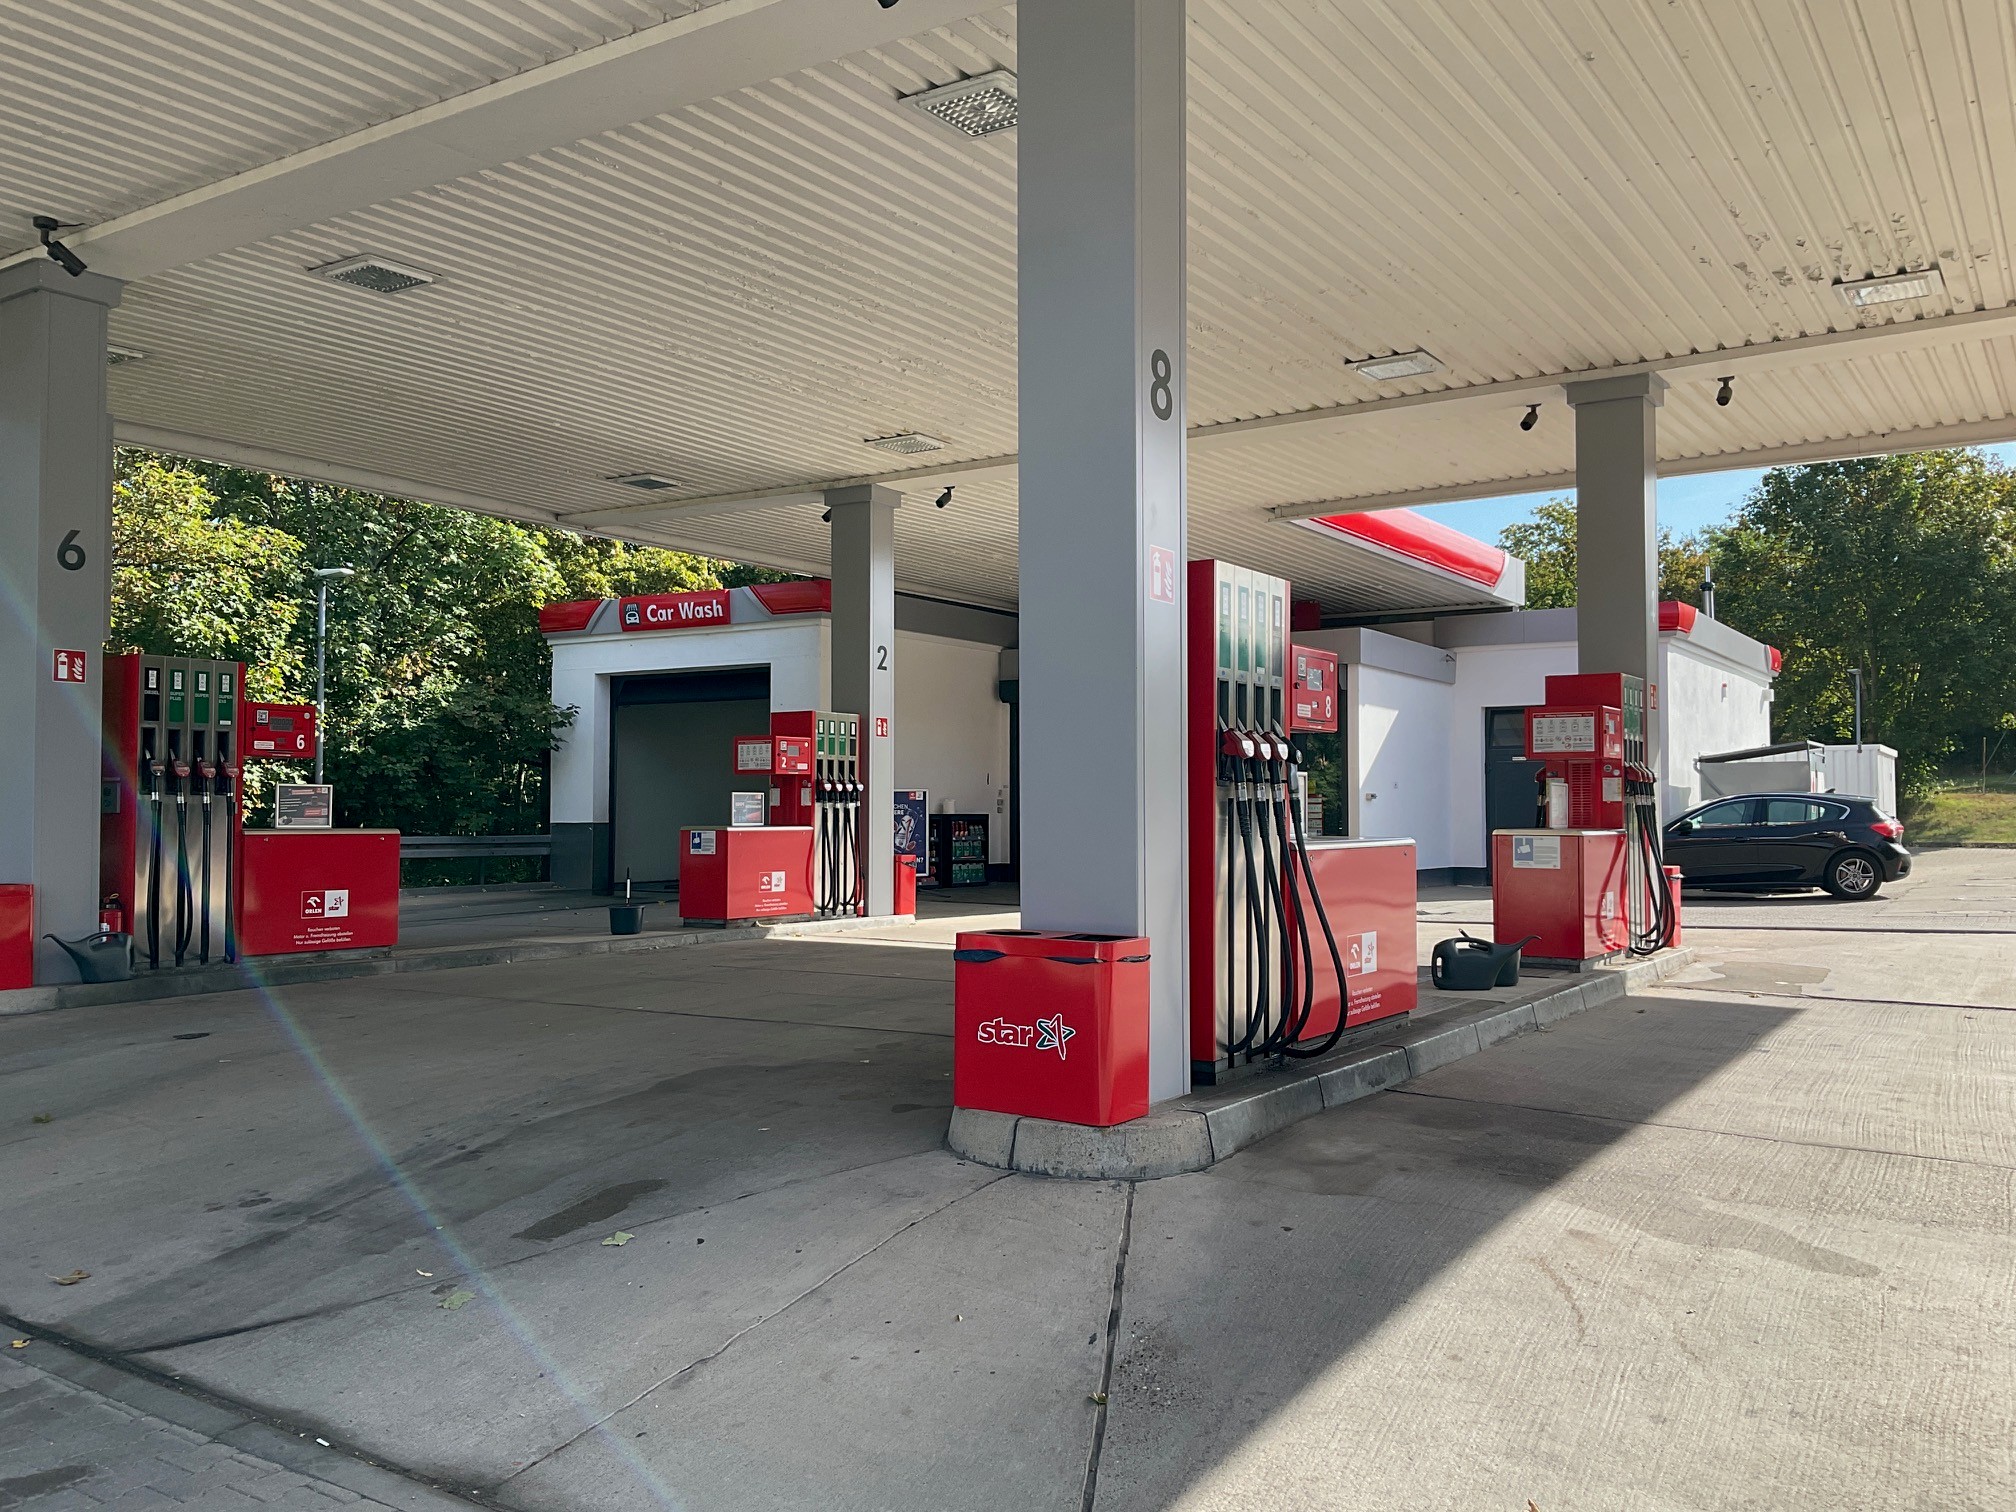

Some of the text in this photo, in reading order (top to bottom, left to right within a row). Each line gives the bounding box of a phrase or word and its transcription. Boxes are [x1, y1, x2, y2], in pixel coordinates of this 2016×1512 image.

[1151, 349, 1172, 421] 8
[57, 529, 86, 571] 6
[646, 599, 723, 622] Car Wash
[877, 645, 888, 671] 2
[1325, 695, 1332, 718] 8
[296, 734, 305, 750] 6
[781, 757, 787, 768] 2
[977, 1016, 1034, 1047] star
